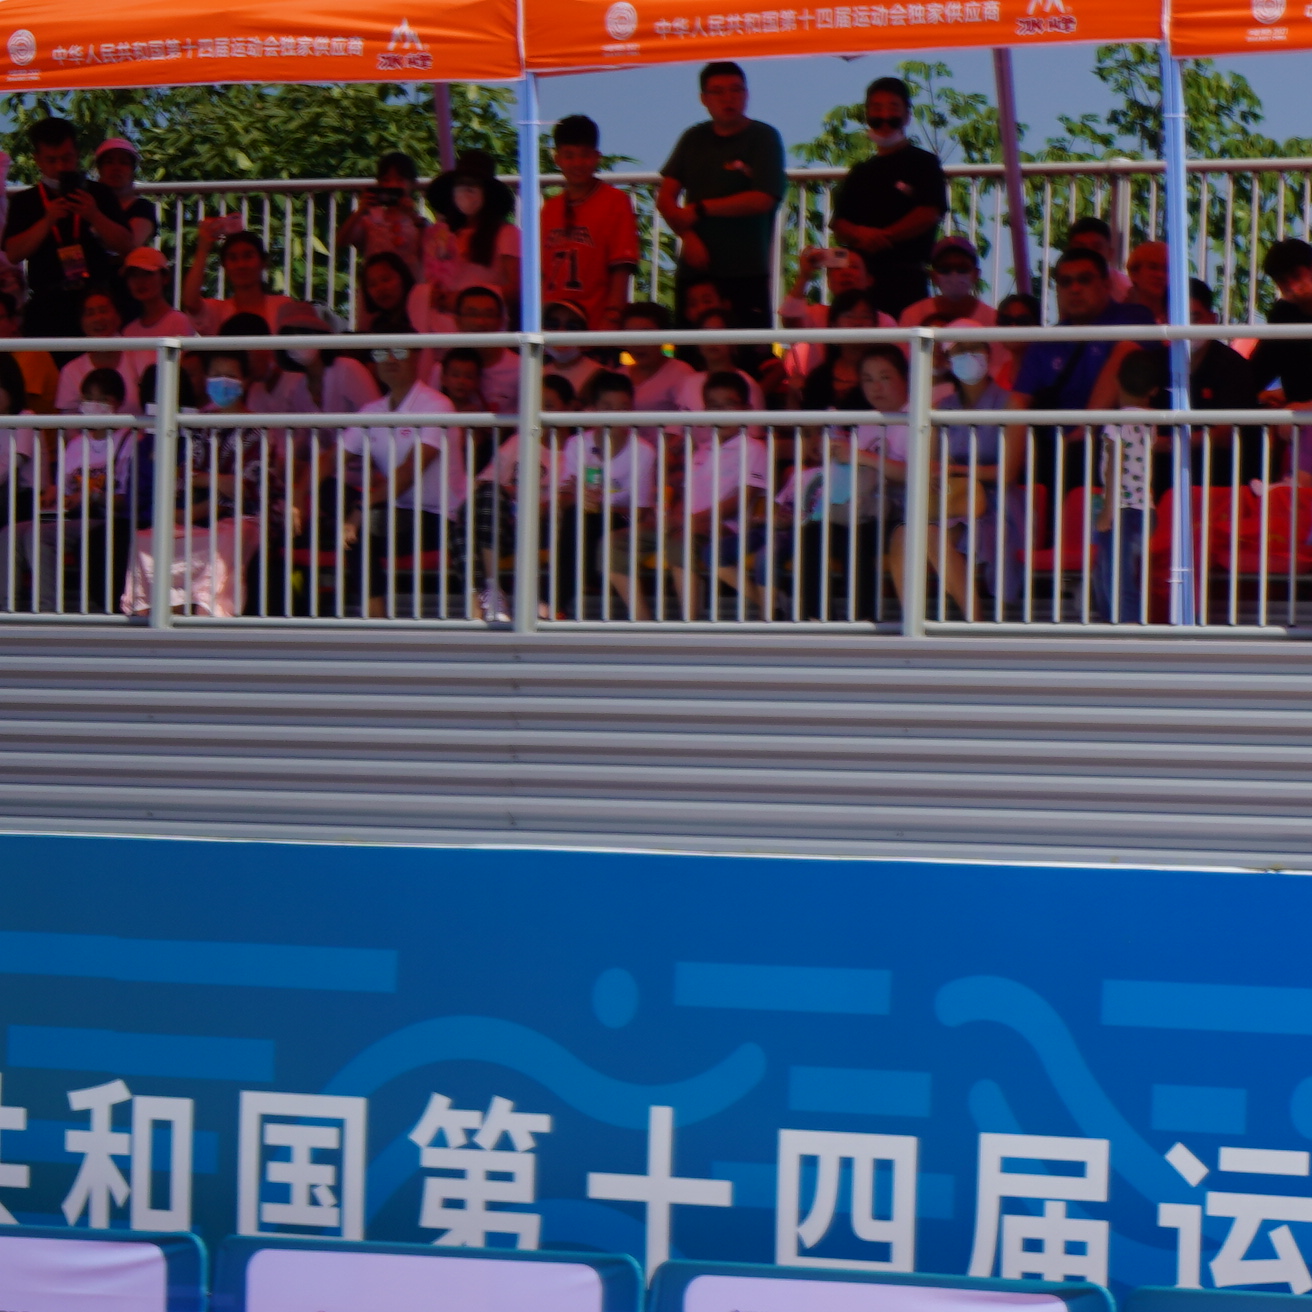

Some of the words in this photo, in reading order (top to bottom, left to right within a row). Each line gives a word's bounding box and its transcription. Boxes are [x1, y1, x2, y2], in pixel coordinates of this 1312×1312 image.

[654, 1, 1000, 40] 中华人民共和国第十四届运动会独家供应商
[52, 36, 365, 65] 中华人民共和国第十四届运动会独家供应商
